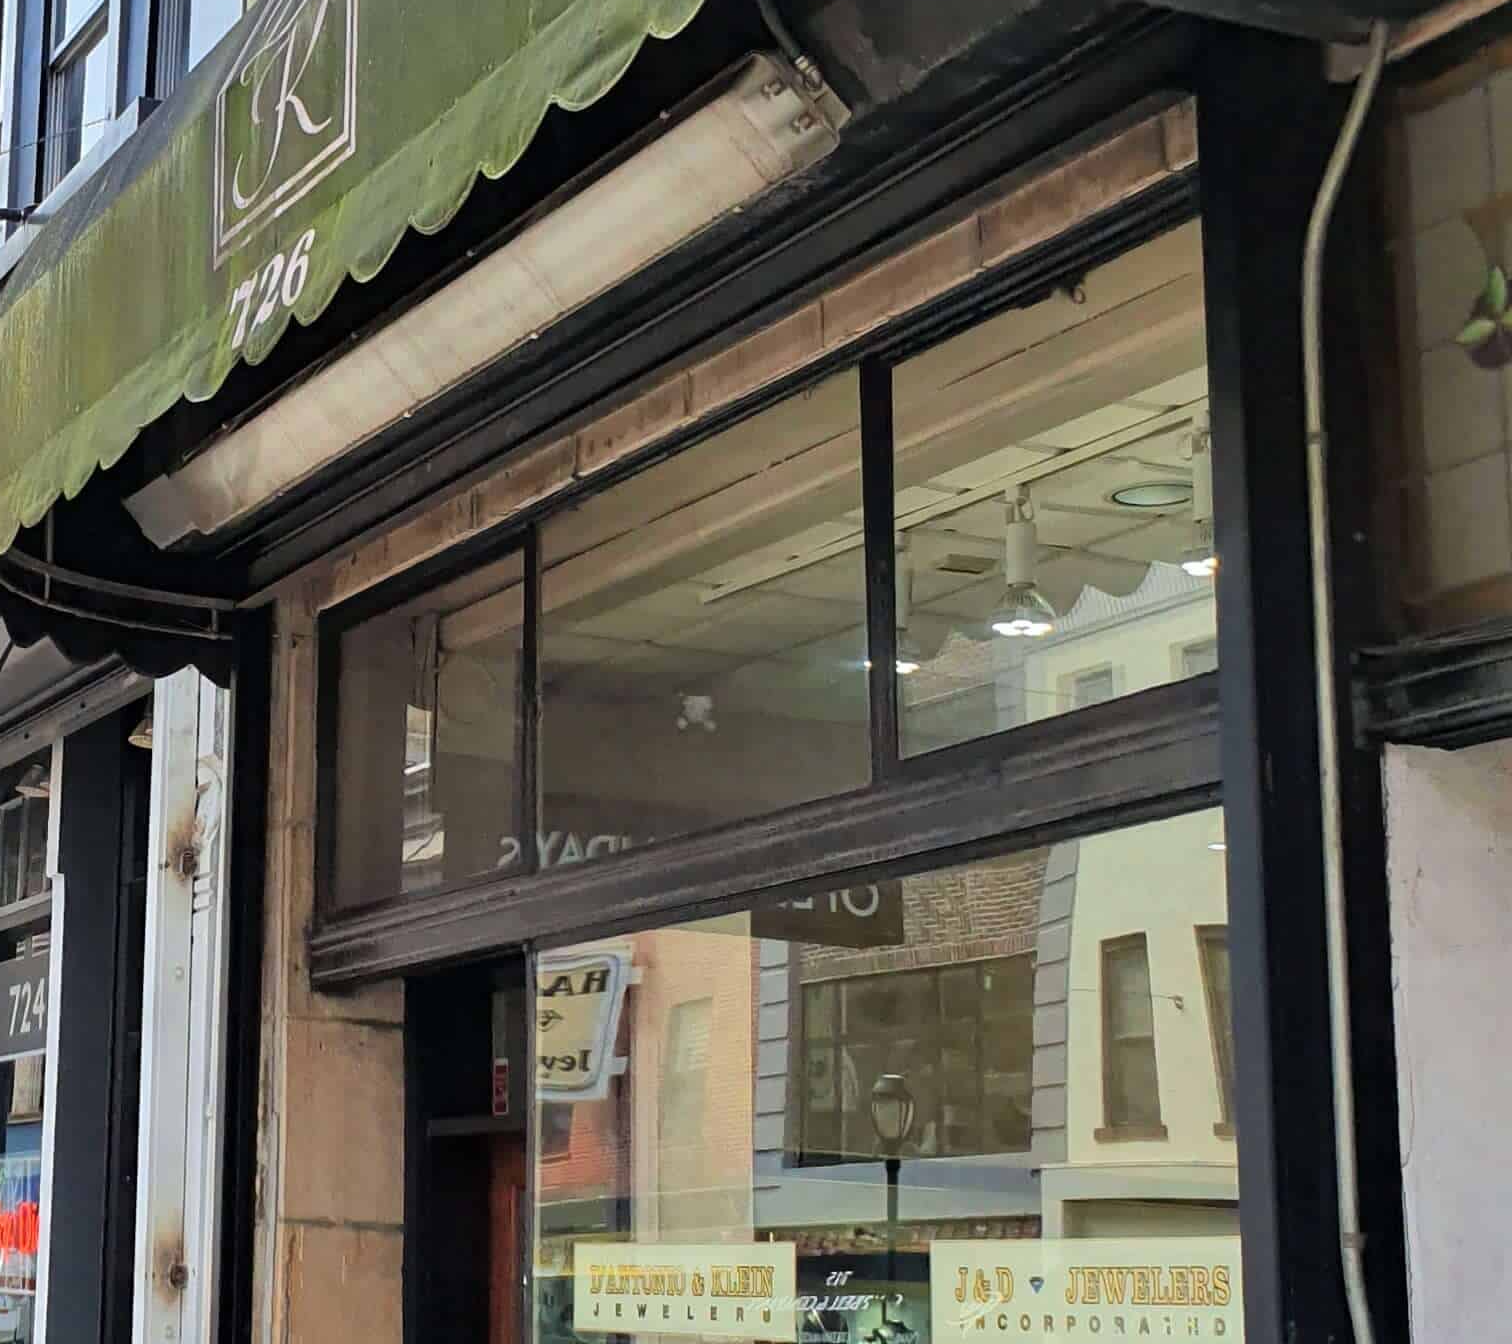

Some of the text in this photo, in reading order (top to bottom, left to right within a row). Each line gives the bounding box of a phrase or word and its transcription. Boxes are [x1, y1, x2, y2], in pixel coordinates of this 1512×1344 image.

[229, 227, 316, 352] 726
[9, 977, 46, 1036] 724
[691, 1266, 705, 1297] &
[710, 1264, 776, 1298] KLEIN
[1064, 1264, 1232, 1306] JEWELERS
